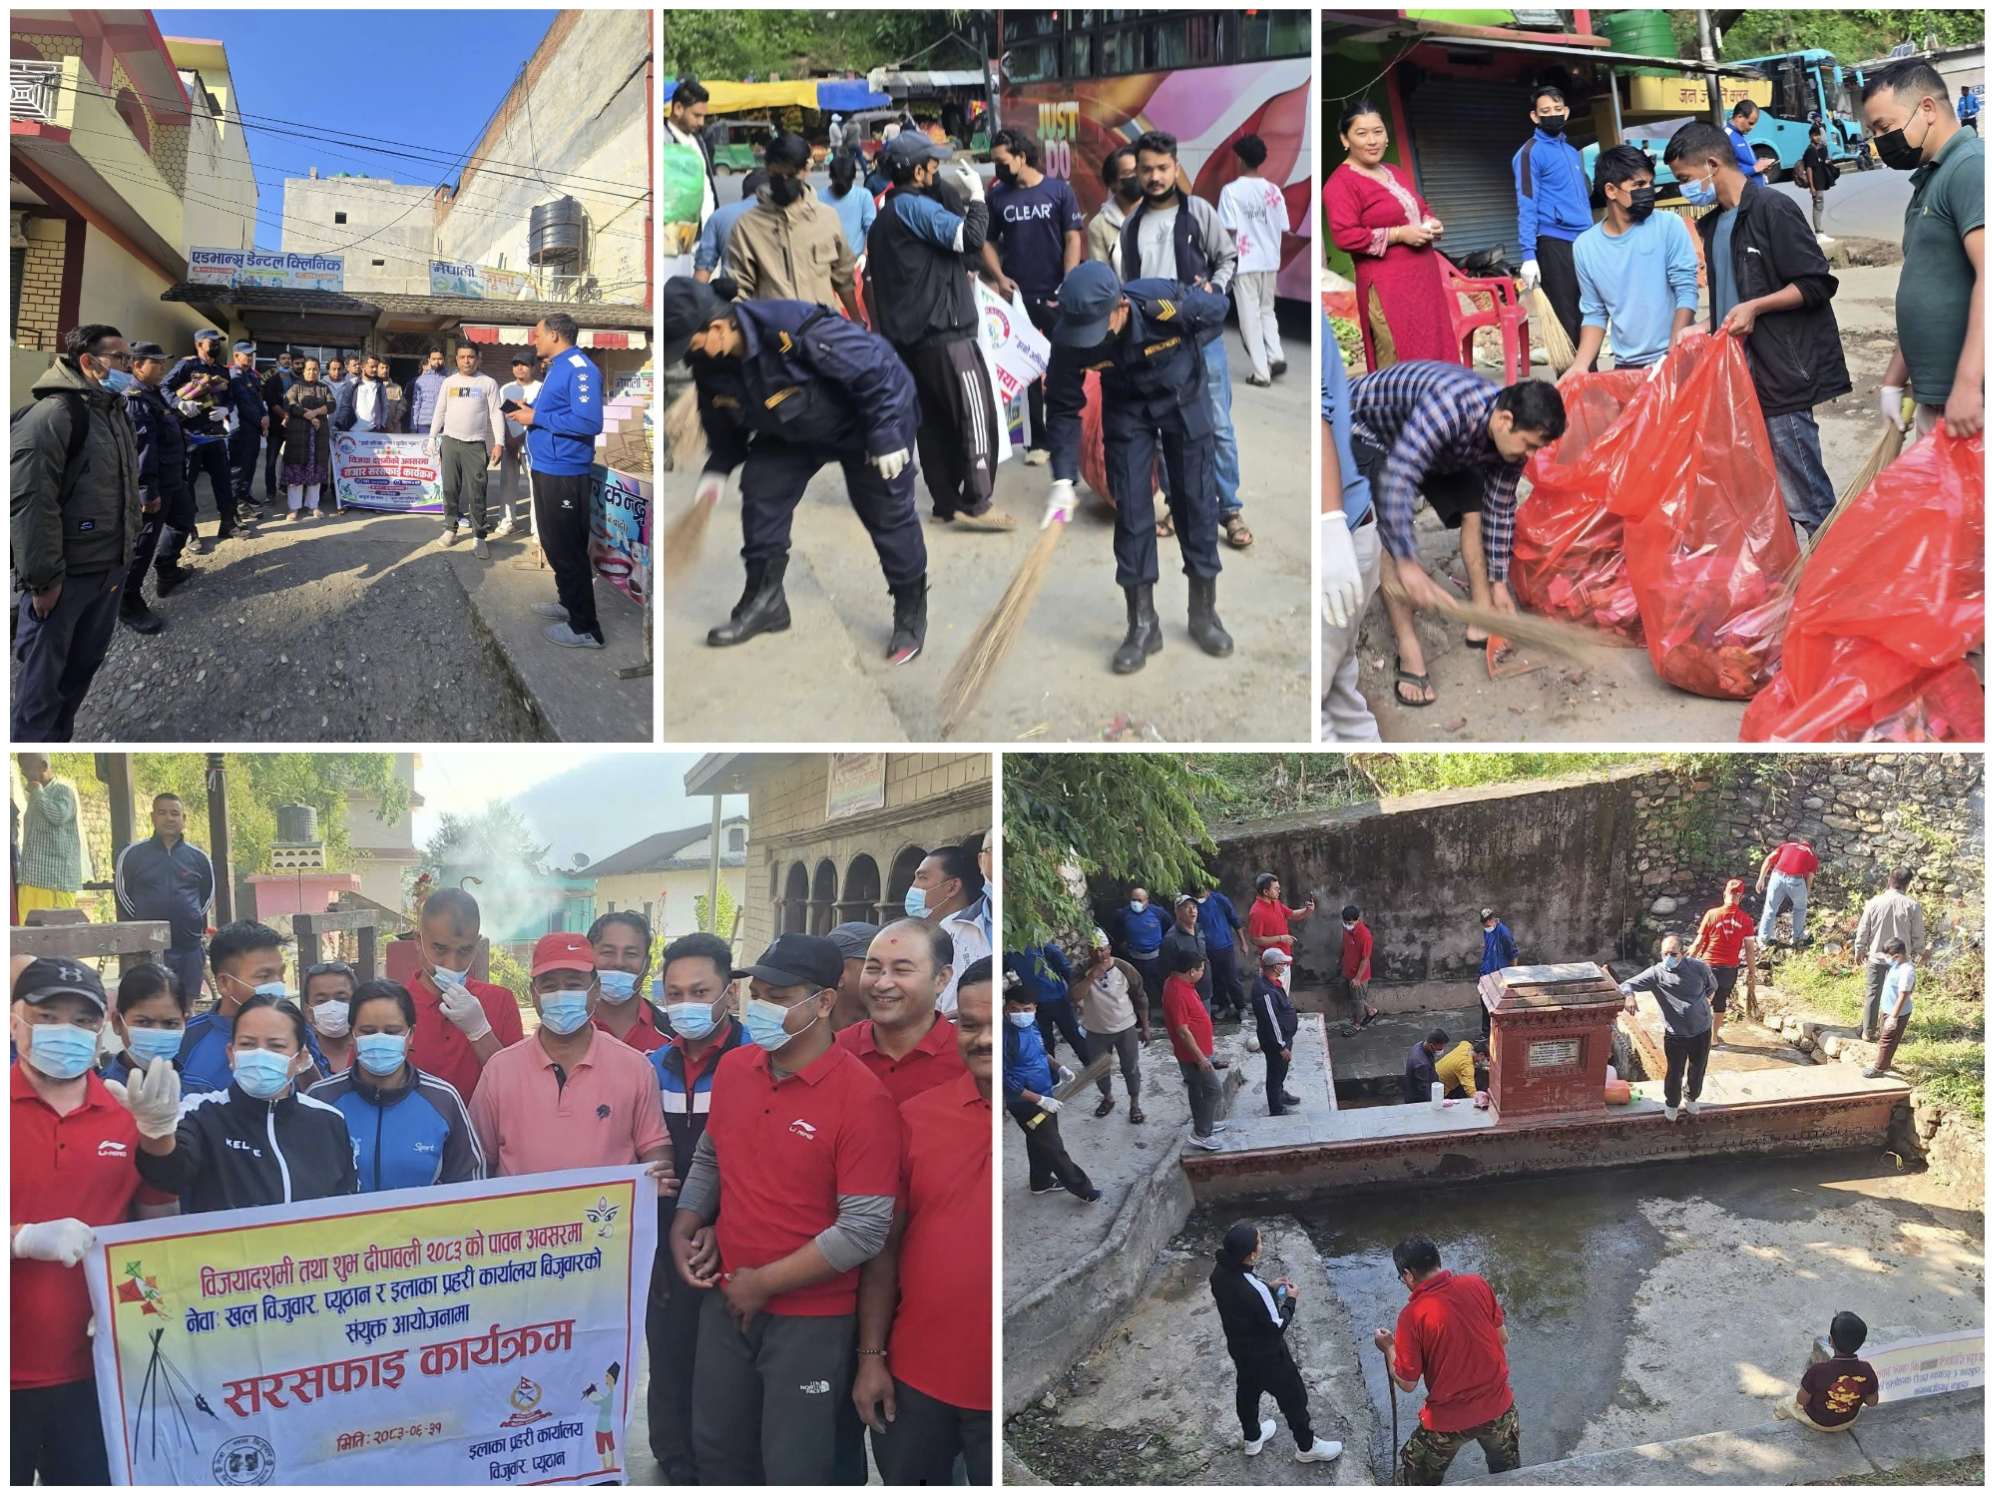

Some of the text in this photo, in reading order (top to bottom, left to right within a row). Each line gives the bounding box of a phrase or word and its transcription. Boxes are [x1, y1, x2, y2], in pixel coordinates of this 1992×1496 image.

[1037, 101, 1080, 141] JUST
[1045, 140, 1072, 180] DO
[1003, 203, 1052, 222] CLEAR
[246, 251, 286, 270] डेन्टल
[286, 252, 342, 272] क्लिनिक
[201, 1221, 584, 1297] विजयादशमी तथा शुभ दीपावली २०८३ को पावन अवसरमा
[224, 1304, 258, 1328] खल
[324, 1284, 372, 1314] प्यूठान
[375, 1283, 387, 1304] र
[389, 1275, 438, 1303] इलाका
[442, 1264, 476, 1296] प्रहरी
[479, 1259, 538, 1287] कार्यालय
[540, 1247, 603, 1280] विजुवारको
[345, 1304, 471, 1345] संयुक्त आयोजनामा
[222, 1318, 577, 1418] सरसफाइ कार्यक्रम
[468, 1420, 585, 1461] इलाका प्रहरी कार्यालय
[532, 1451, 566, 1473] प्यूठान
